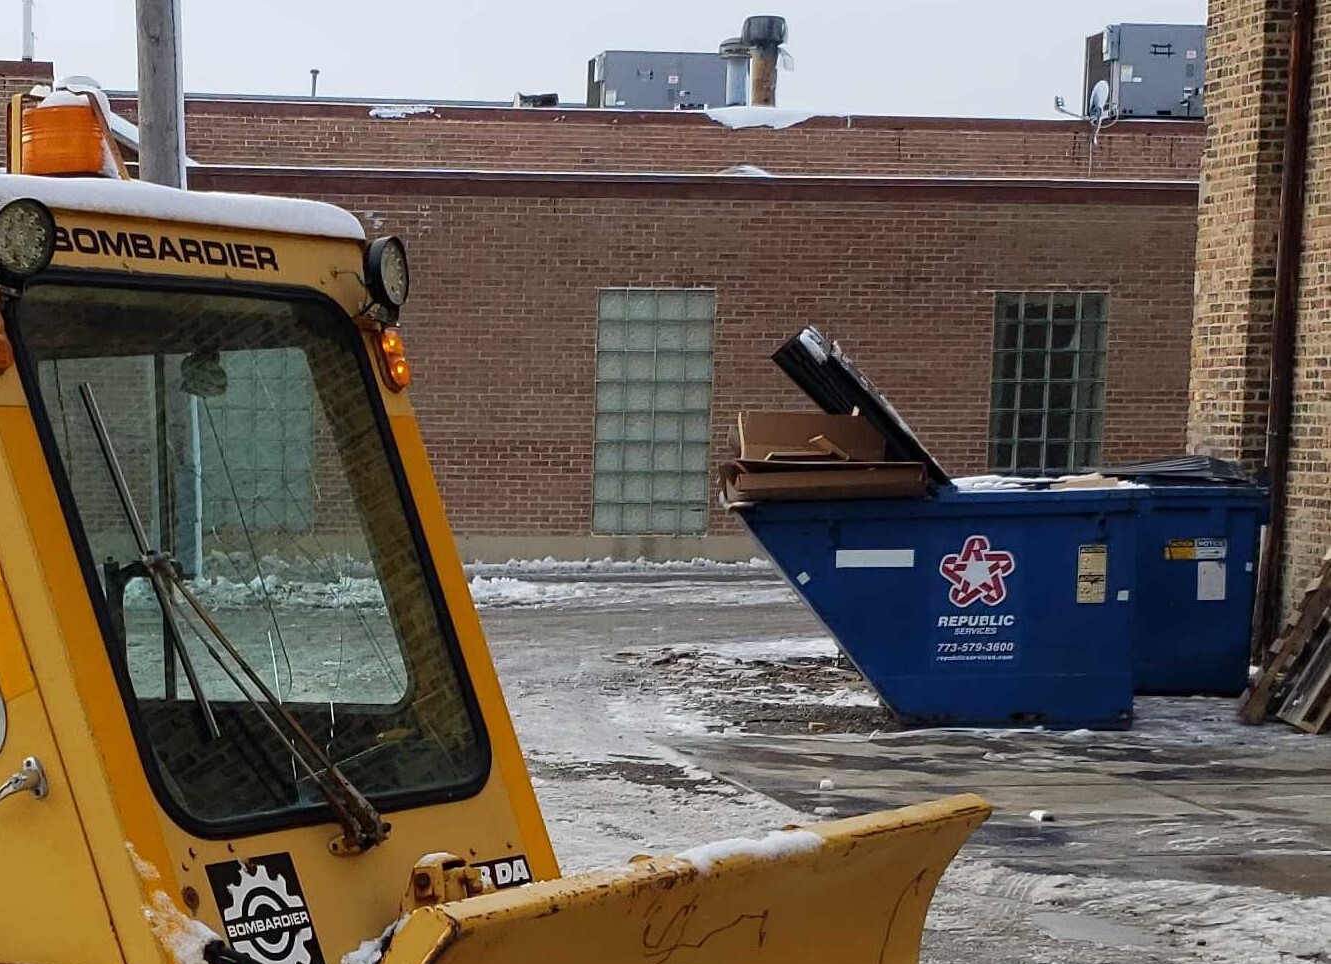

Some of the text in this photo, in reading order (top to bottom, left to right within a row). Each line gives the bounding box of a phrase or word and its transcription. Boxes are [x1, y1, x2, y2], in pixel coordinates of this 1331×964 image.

[53, 226, 279, 271] BOMBARDIER
[937, 615, 1015, 628] REPUBLIC
[954, 627, 997, 636] SERVICES
[937, 642, 1014, 653] 773-579-3600
[495, 858, 530, 885] DA
[226, 911, 310, 938] BOMBARDIER
